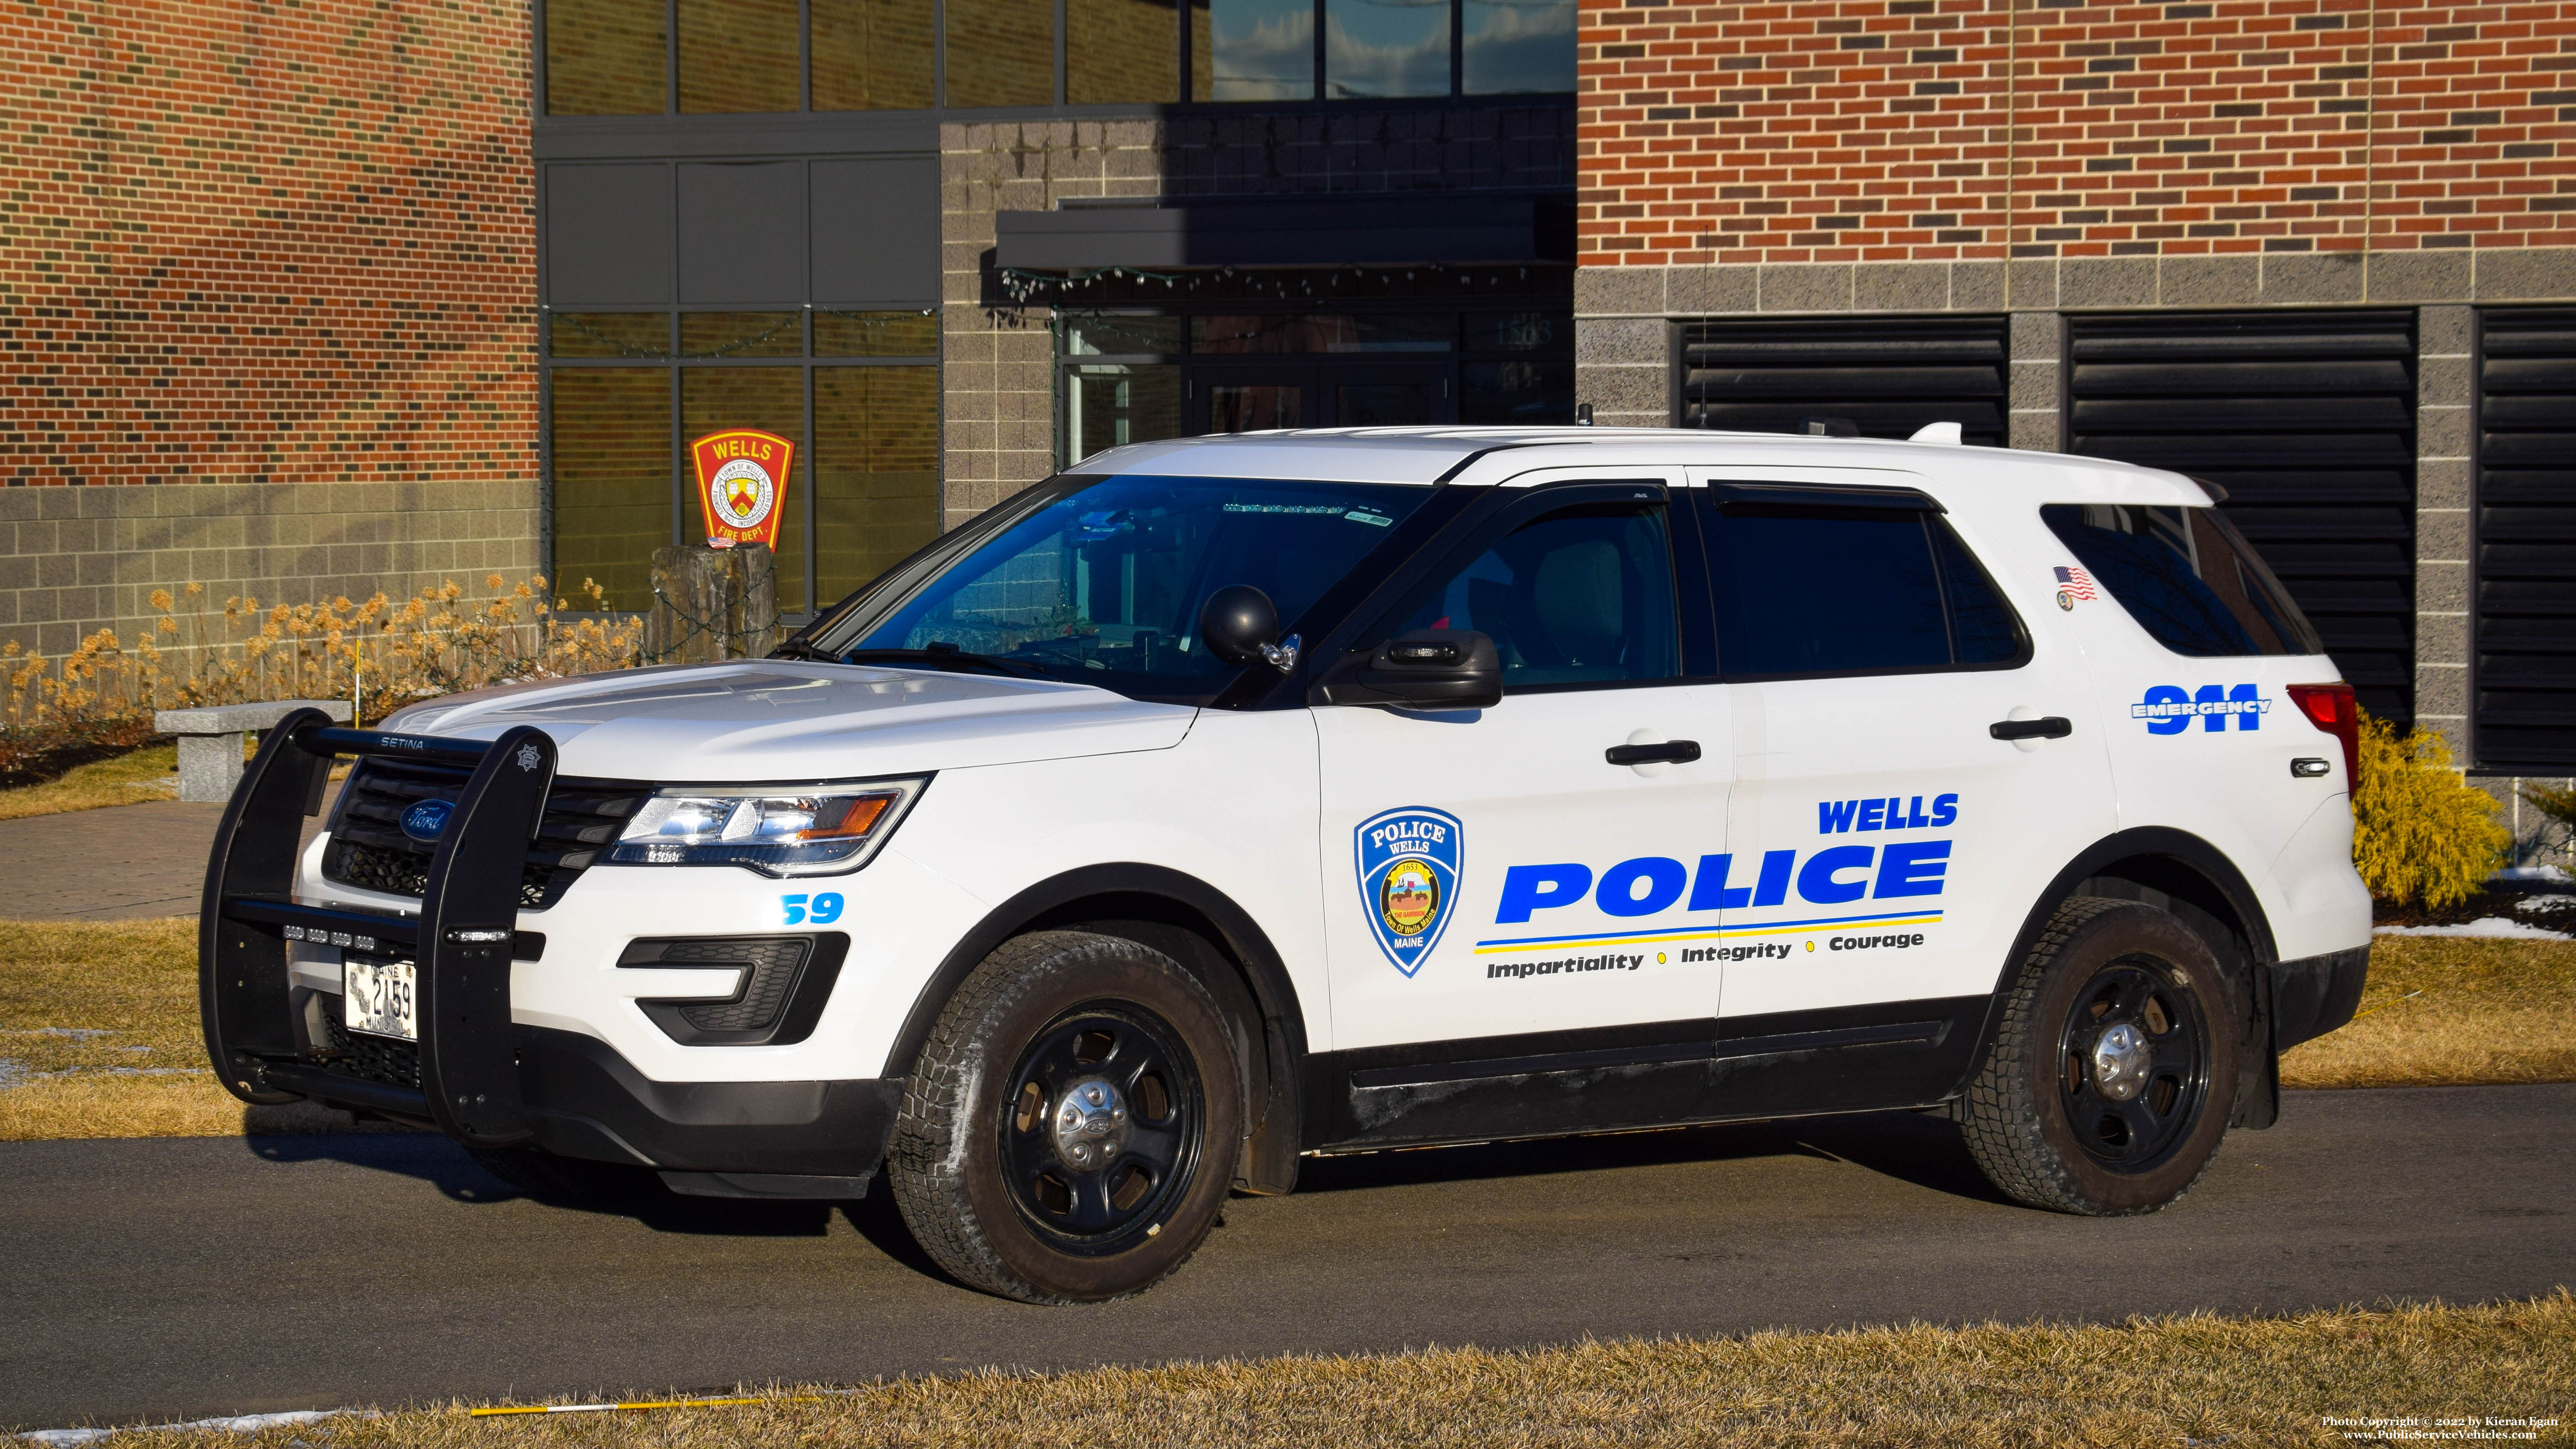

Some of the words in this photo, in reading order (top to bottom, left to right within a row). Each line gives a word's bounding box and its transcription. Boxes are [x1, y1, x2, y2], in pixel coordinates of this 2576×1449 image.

[712, 440, 771, 460] WELLS
[722, 465, 736, 477] TOWN
[746, 464, 762, 478] WELLS
[712, 491, 723, 515] FOUNDED
[738, 503, 770, 526] INCORPORATED
[718, 525, 738, 541] FIRE
[2131, 699, 2272, 719] EMERGENCY
[2144, 684, 2259, 736] 911
[381, 737, 423, 750] SETINA
[408, 807, 445, 830] Ford
[1818, 793, 1958, 834] WELLS
[1371, 821, 1446, 848] POLICE
[1389, 840, 1430, 854] WELLS
[1403, 863, 1418, 871] 1653
[1494, 840, 1953, 924] POLICE
[779, 892, 844, 925] 59
[1385, 911, 1396, 928] Town
[1396, 924, 1404, 932] Of
[1405, 925, 1421, 933] Wells
[1420, 908, 1435, 927] Maine
[1394, 936, 1424, 948] MAINE
[1487, 954, 1644, 978] Impartiality
[1681, 942, 1792, 963] Integrity
[1829, 933, 1924, 951] Courage
[373, 978, 410, 1020] 2159
